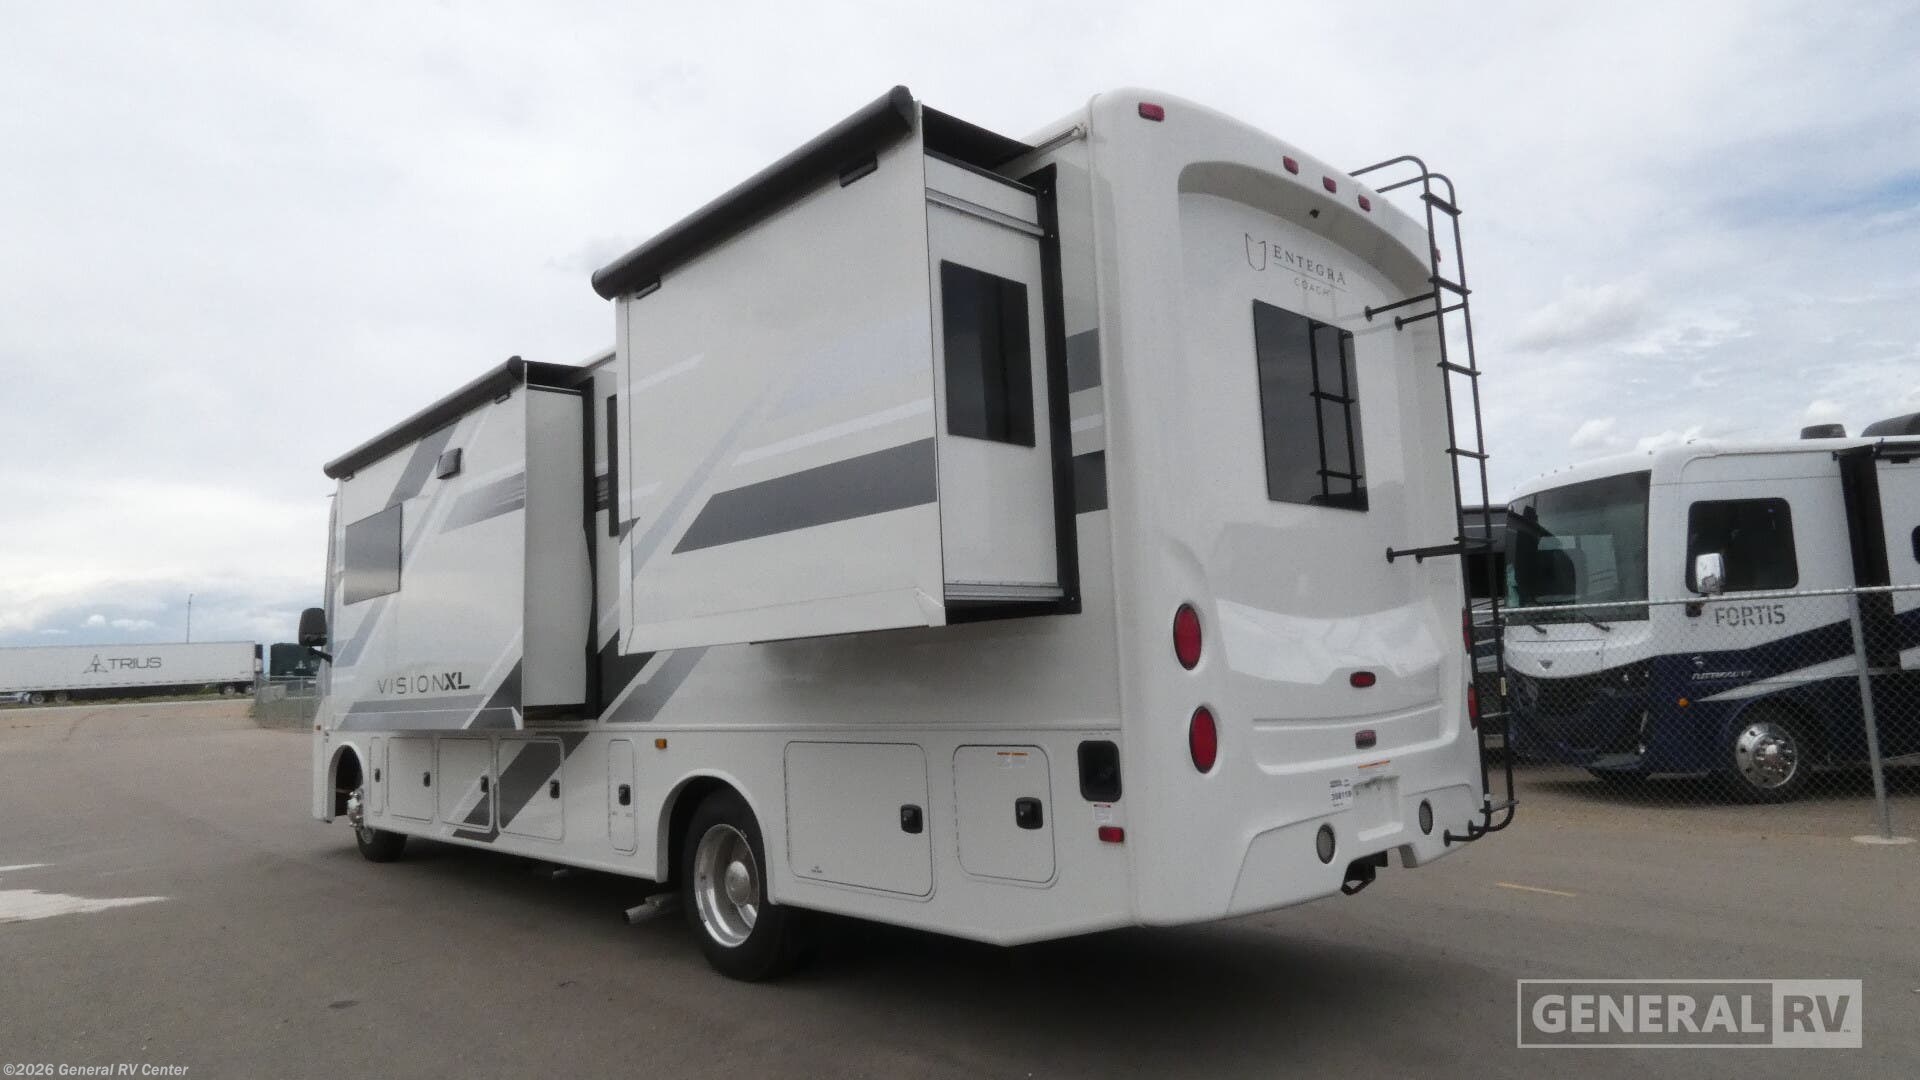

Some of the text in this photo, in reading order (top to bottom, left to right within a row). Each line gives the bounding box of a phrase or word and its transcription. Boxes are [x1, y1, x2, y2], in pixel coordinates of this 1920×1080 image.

[1273, 244, 1346, 285] ENTEGRA
[1294, 277, 1331, 295] COACH
[1715, 604, 1786, 626] FORTIS
[108, 657, 162, 669] TRIUS
